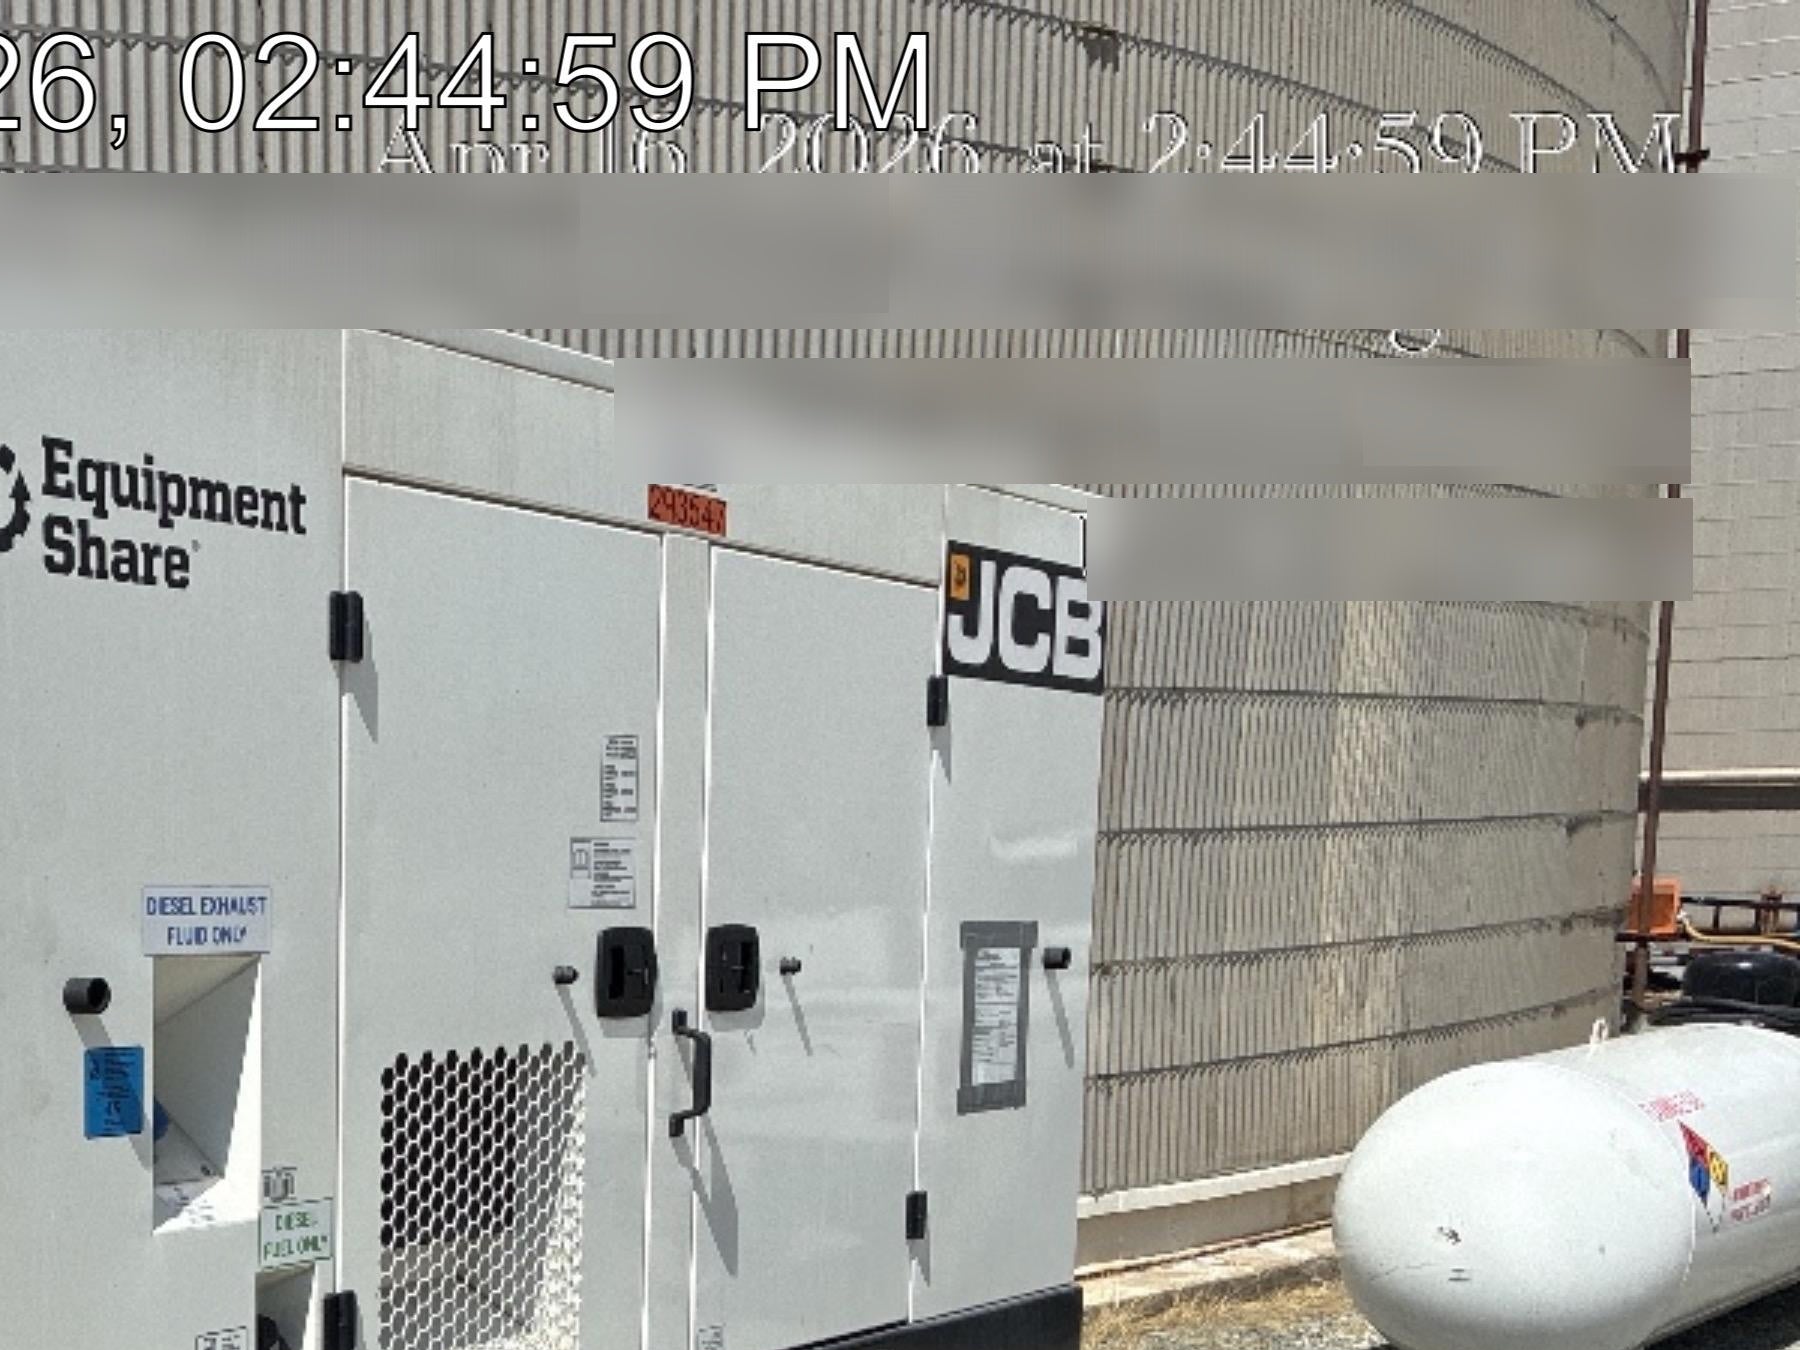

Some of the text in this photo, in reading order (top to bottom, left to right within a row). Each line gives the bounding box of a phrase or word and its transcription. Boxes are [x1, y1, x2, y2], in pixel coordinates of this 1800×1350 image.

[41, 435, 307, 535] Equipment
[44, 514, 190, 589] Share
[947, 559, 1102, 680] JCB
[145, 896, 268, 916] DIESEL EXHAUST
[167, 926, 208, 945] FLUID
